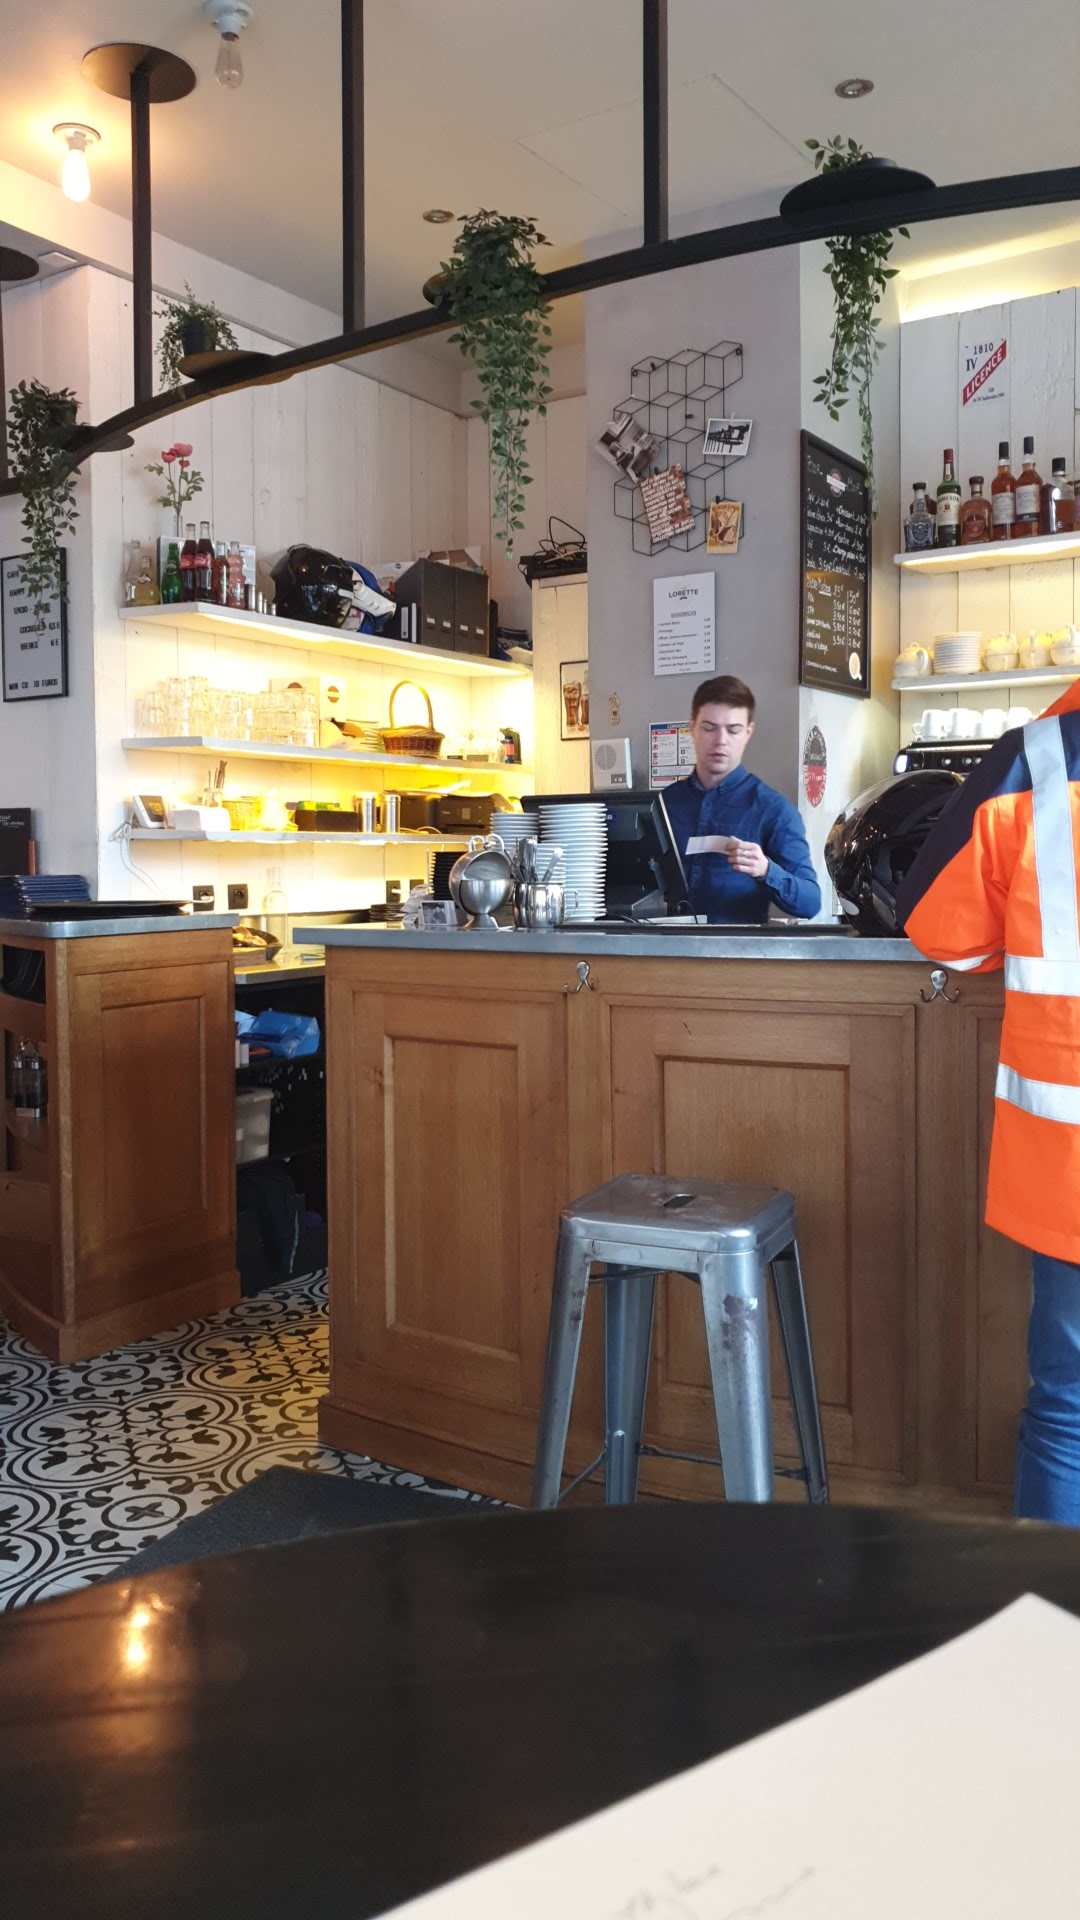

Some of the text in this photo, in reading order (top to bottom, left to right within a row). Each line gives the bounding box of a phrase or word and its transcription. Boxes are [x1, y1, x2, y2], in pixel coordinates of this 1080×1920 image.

[974, 342, 994, 354] 1810
[966, 357, 978, 371] IV
[966, 348, 1002, 399] LICENCE
[10, 588, 24, 596] HAPPY
[669, 589, 698, 598] LORETTE
